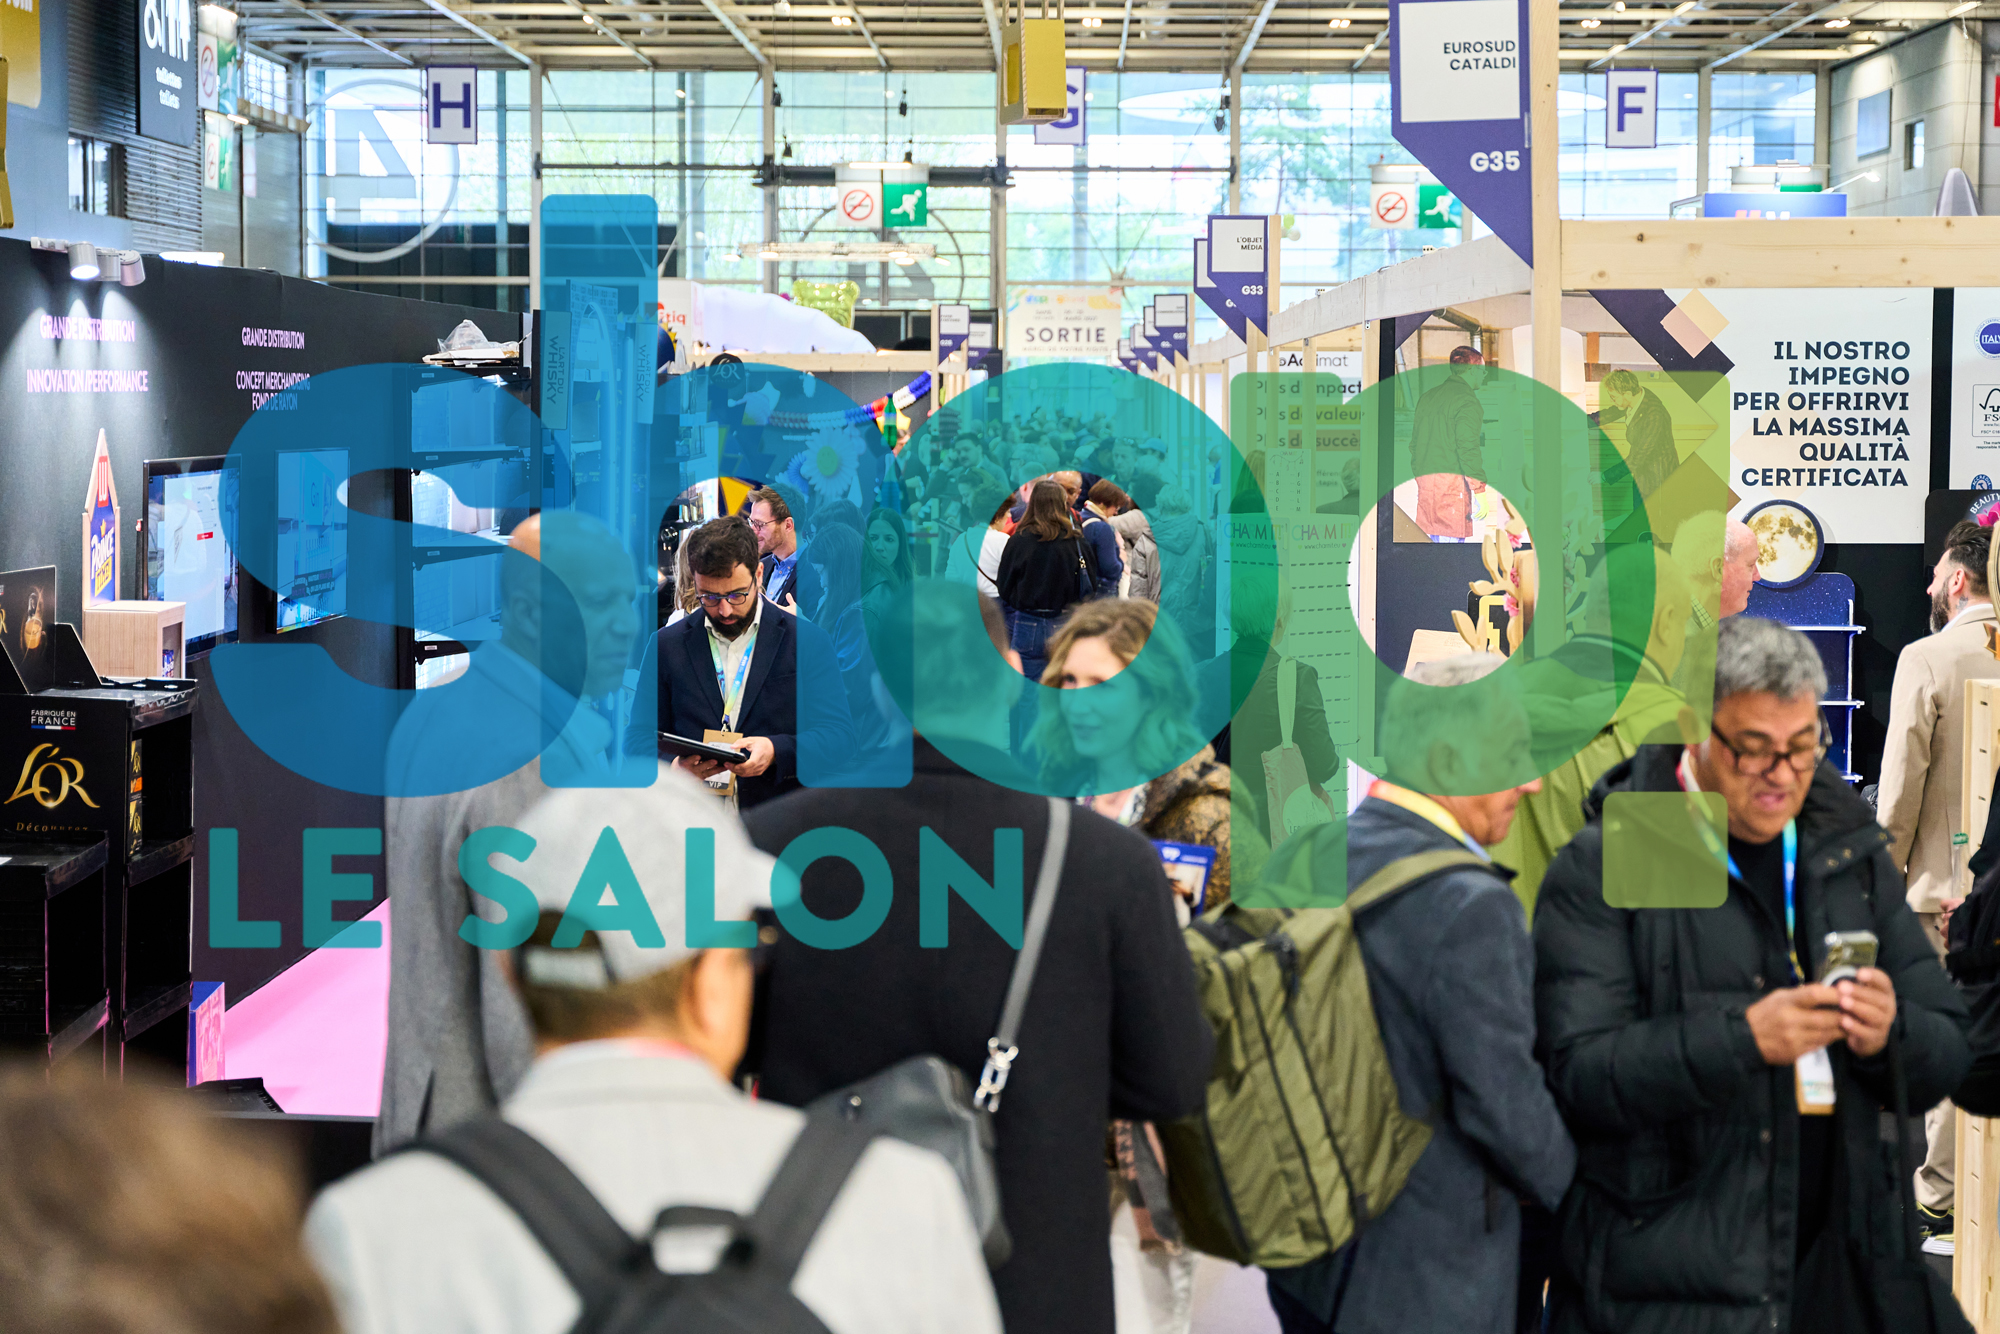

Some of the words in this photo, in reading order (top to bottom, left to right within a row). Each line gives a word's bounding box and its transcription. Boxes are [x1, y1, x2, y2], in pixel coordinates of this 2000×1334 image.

[1443, 40, 1516, 54] EUROSUD
[1450, 57, 1517, 71] CATALDI
[432, 82, 472, 129] H
[1616, 86, 1647, 133] F
[1469, 151, 1521, 172] G35
[1240, 243, 1263, 251] MÉDIA
[1241, 285, 1264, 295] G33
[40, 314, 78, 340] GRANDE
[79, 317, 136, 342] DISTRIBUTION
[1025, 327, 1105, 342] SORTIE
[241, 327, 267, 347] GRANDE
[268, 329, 305, 350] DISTRIBUTION
[1773, 341, 1798, 360] IL
[1804, 340, 1911, 361] NOSTRO
[546, 335, 559, 405] WHISKY
[557, 347, 566, 376] L'ART
[26, 369, 83, 393] INNOVATION
[236, 370, 264, 389] CONCEPT
[265, 371, 311, 391] MERCHANDISING
[636, 344, 647, 402] WHISKY
[1788, 366, 1910, 386] IMPEGNO
[557, 379, 565, 394] DU
[644, 378, 651, 394] DU
[1257, 380, 1286, 394] Pls
[252, 392, 269, 411] FOND
[270, 392, 279, 411] DE
[279, 393, 298, 411] RAYON
[1733, 391, 1780, 411] PER
[1787, 391, 1909, 411] OFFRIRVI
[1257, 407, 1286, 421] Pls
[1984, 413, 2000, 422] FS
[1752, 417, 1783, 436] LA
[1789, 417, 1910, 436] MASSIMA
[1257, 434, 1286, 447] Pls
[1315, 434, 1361, 448] succè
[1799, 437, 1910, 462] QUALITÀ
[1741, 467, 1909, 487] CERTIFICATA
[1970, 493, 2000, 514] BEAUTY
[31, 709, 65, 717] FABRIQUÉ
[31, 716, 76, 726] FRANCE
[3, 743, 101, 809] L'OR
[709, 781, 722, 789] VIP
